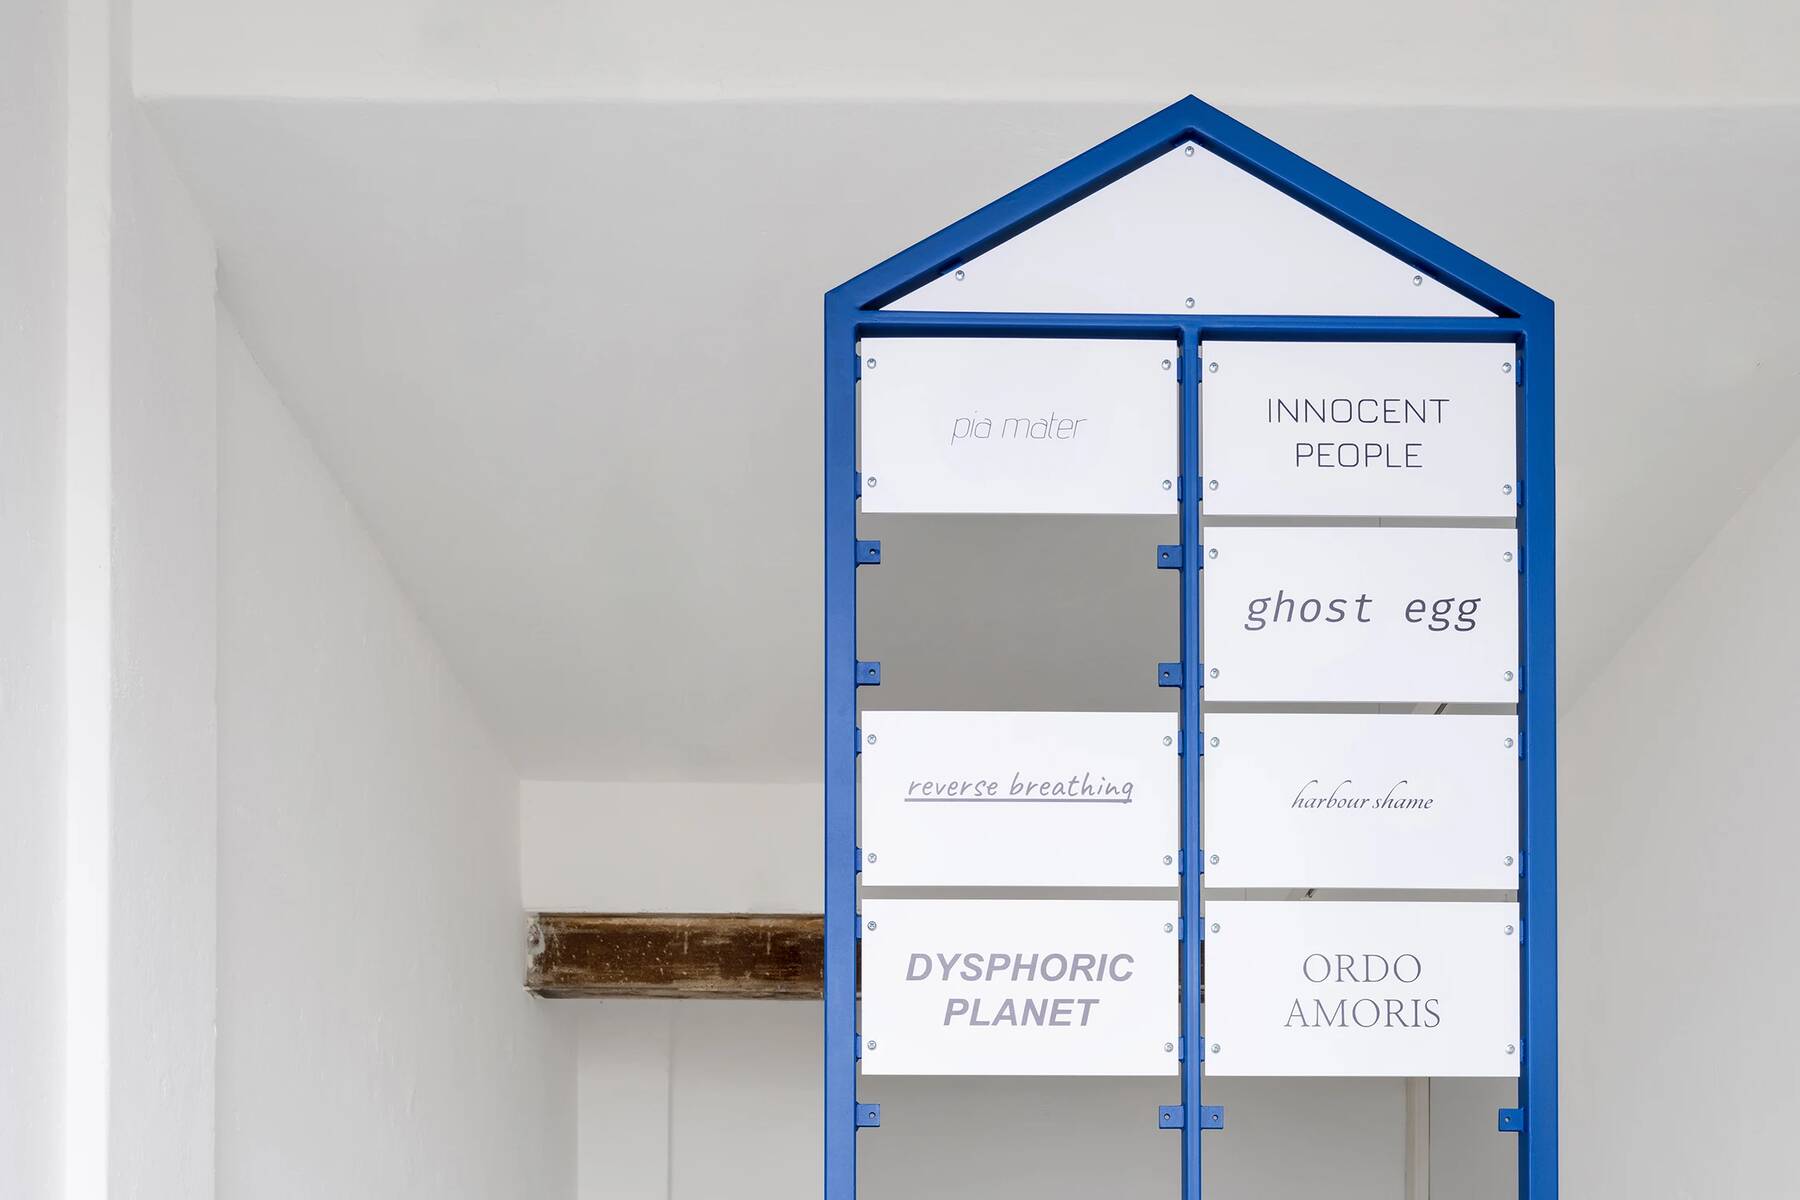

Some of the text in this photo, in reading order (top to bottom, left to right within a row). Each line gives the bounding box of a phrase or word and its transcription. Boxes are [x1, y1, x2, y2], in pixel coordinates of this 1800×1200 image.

[1268, 398, 1450, 424] INNOCENT
[950, 410, 1088, 446] pia mater
[1295, 442, 1424, 468] PEOPLE
[1244, 589, 1482, 632] ghost egg
[906, 771, 1134, 804] reverse breathing
[1291, 779, 1434, 809] harbour shame
[905, 953, 1135, 982] DYSPHORIC
[1302, 953, 1422, 983] ORDO
[943, 998, 1100, 1027] PLANET
[1283, 998, 1441, 1028] AMORIS
